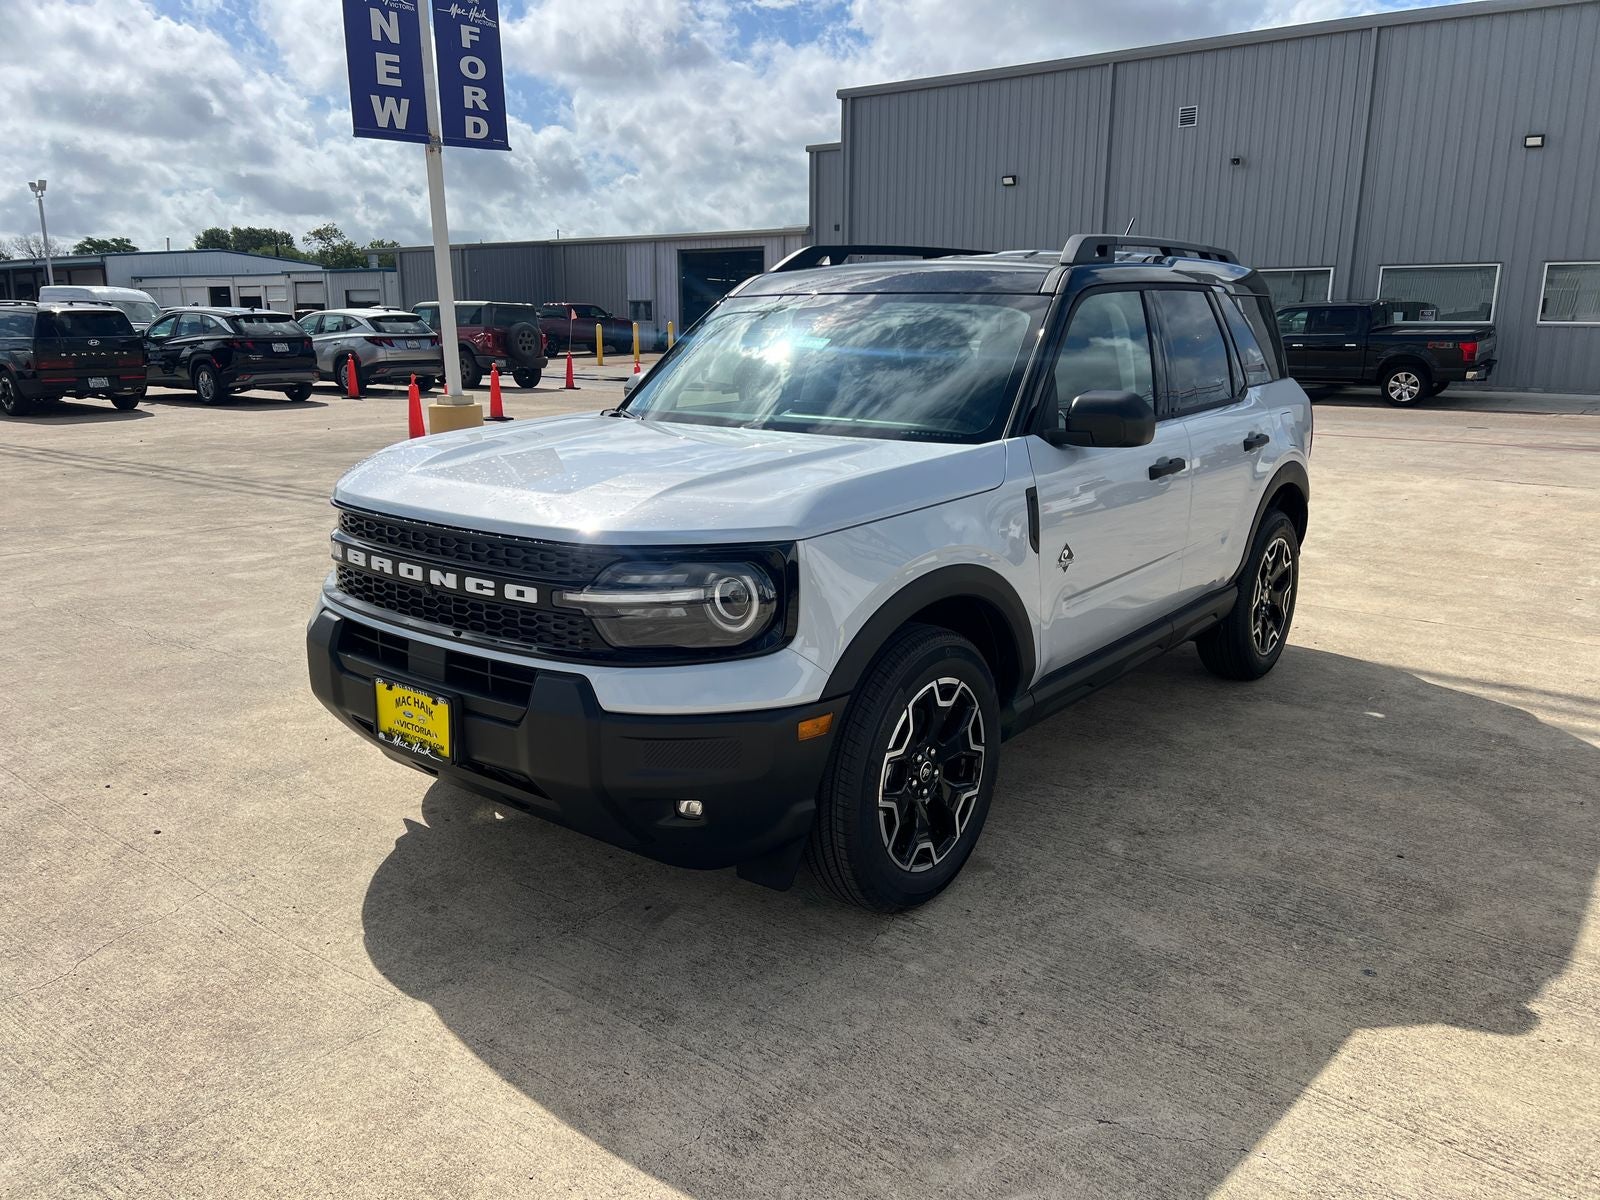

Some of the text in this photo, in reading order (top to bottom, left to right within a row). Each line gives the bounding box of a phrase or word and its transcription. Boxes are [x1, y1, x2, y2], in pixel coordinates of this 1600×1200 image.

[388, 2, 415, 12] VICTORIA
[443, 3, 491, 22] Mac Haik
[473, 18, 497, 28] VICTORIA
[369, 8, 410, 130] NEW
[459, 24, 490, 140] FORD
[346, 547, 538, 604] BRONCO
[395, 696, 412, 709] MAC
[413, 698, 435, 720] HAIK
[398, 720, 431, 737] VICTORIA
[388, 734, 437, 760] Mac Haik
